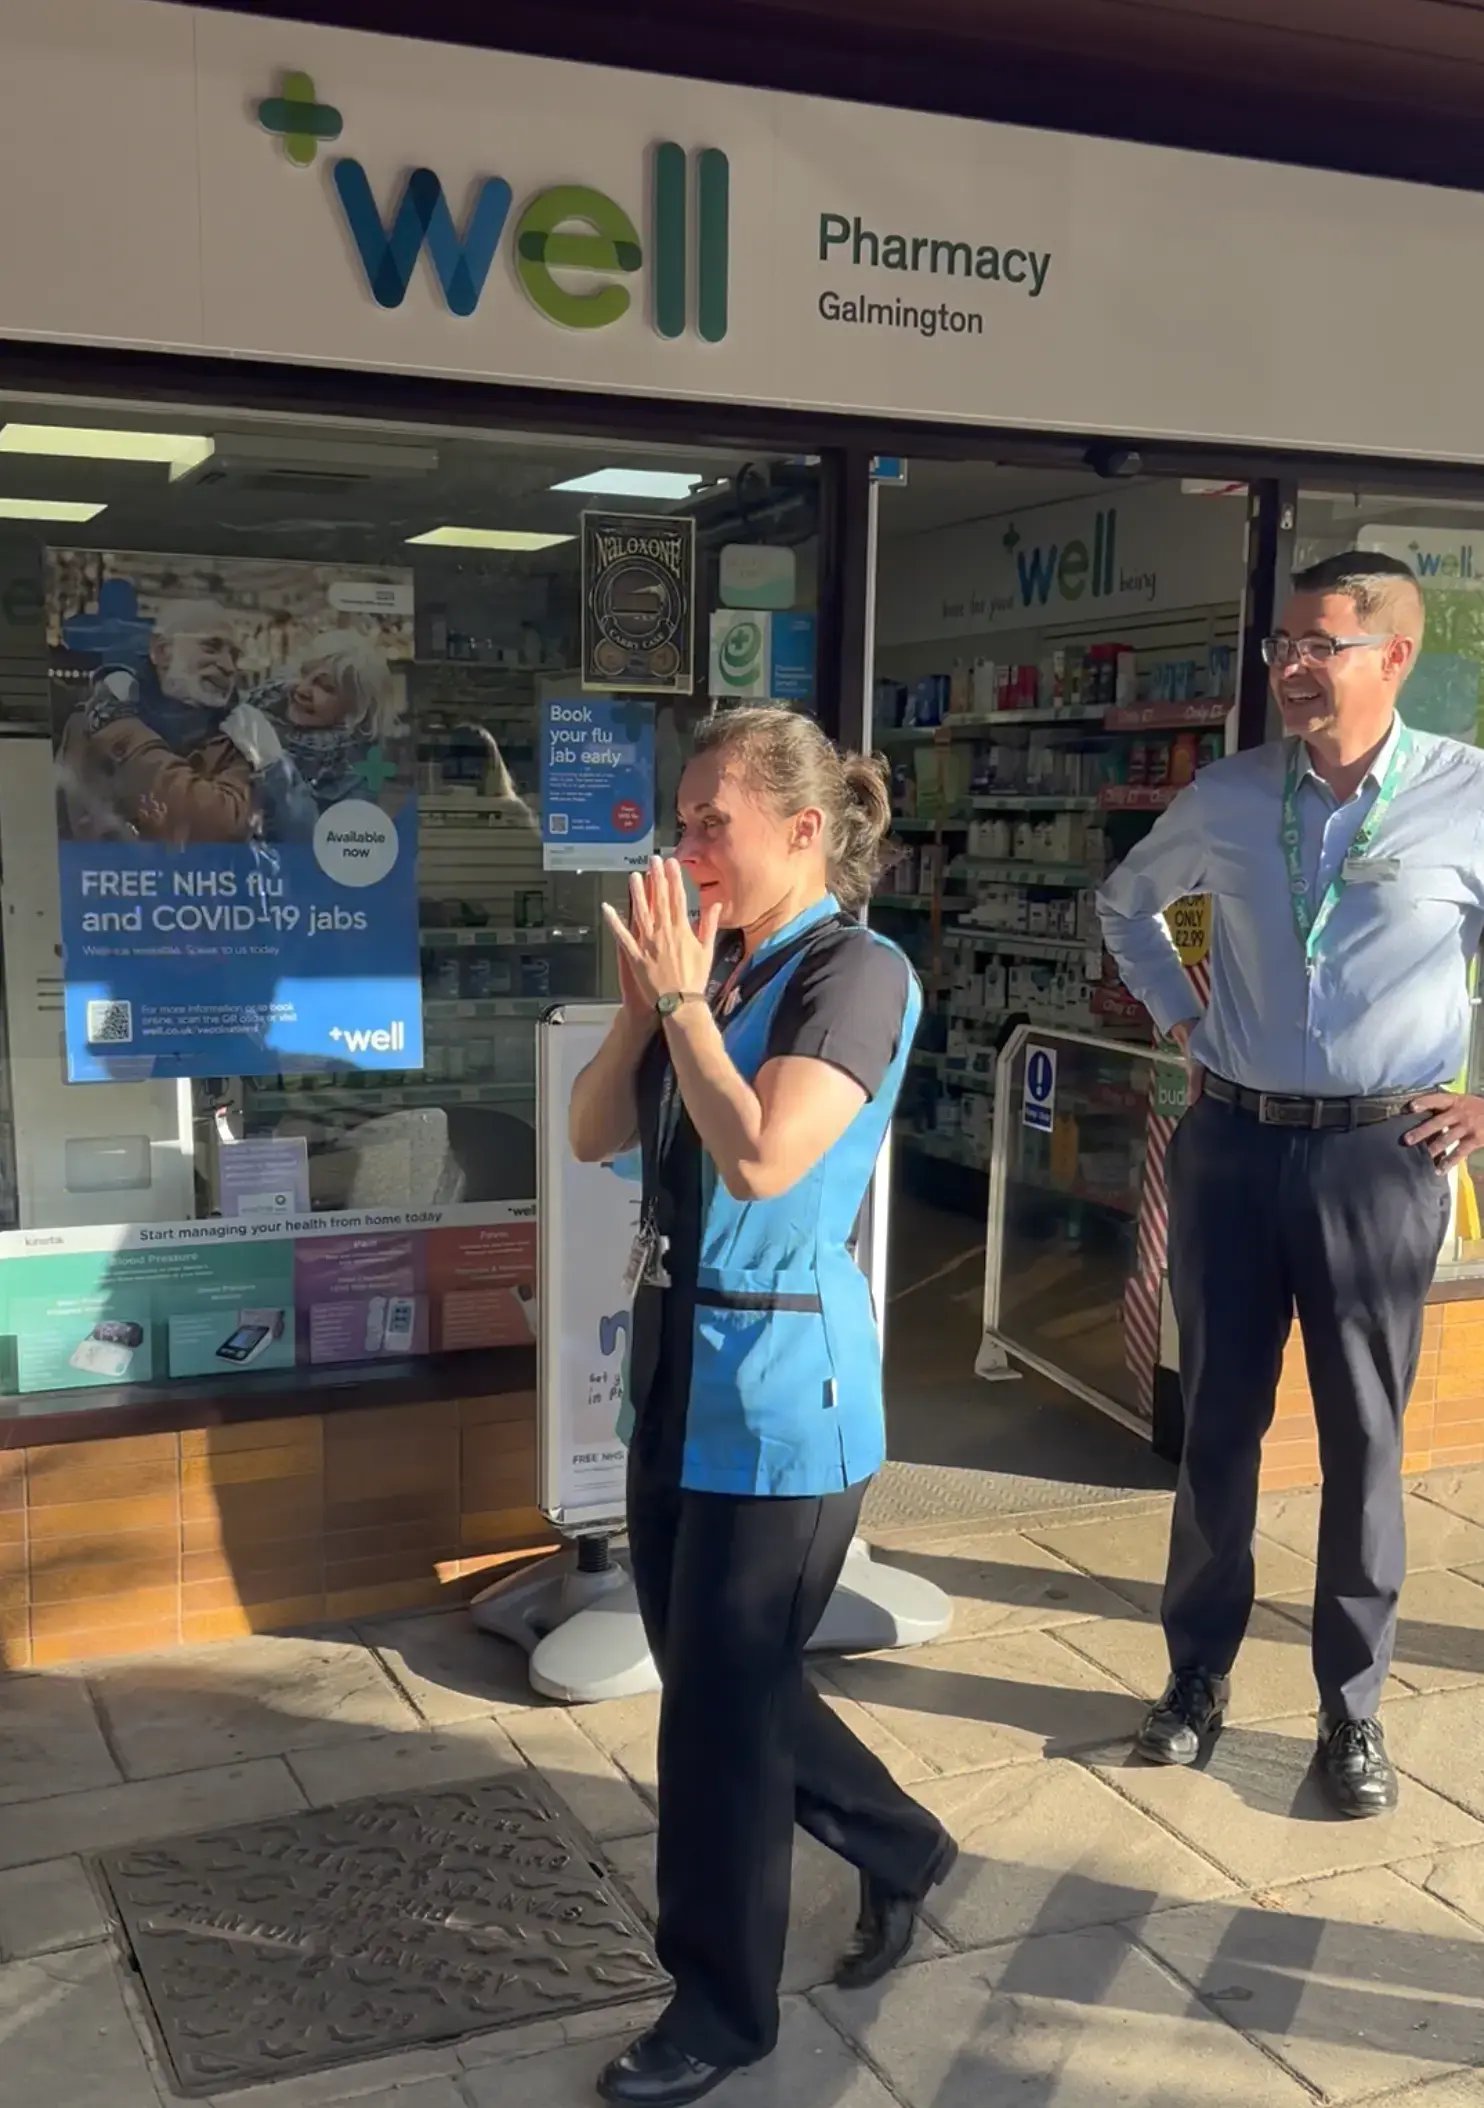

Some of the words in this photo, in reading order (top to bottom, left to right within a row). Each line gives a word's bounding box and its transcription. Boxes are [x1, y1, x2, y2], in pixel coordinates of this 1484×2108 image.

[818, 212, 1052, 298] Pharmacy
[818, 291, 983, 337] Galmington
[550, 705, 593, 722] Book
[550, 729, 587, 745] your
[592, 728, 613, 743] flu
[549, 747, 577, 767] jab
[581, 749, 622, 768] early
[326, 830, 386, 843] Available
[343, 848, 371, 858] now
[173, 870, 237, 898] NHS
[245, 870, 284, 898] flu
[81, 905, 142, 932] and
[152, 904, 300, 932] COVID-19
[307, 904, 368, 937] jabs
[1174, 909, 1204, 927] ONLY
[1175, 929, 1205, 948] £2.99
[250, 944, 280, 956] today
[139, 1229, 174, 1241] Start
[179, 1223, 247, 1238] managing
[251, 1221, 282, 1235] your
[285, 1217, 327, 1231] health
[330, 1216, 361, 1228] from
[365, 1214, 401, 1225] home
[405, 1211, 442, 1224] today
[571, 1453, 597, 1465] FREE
